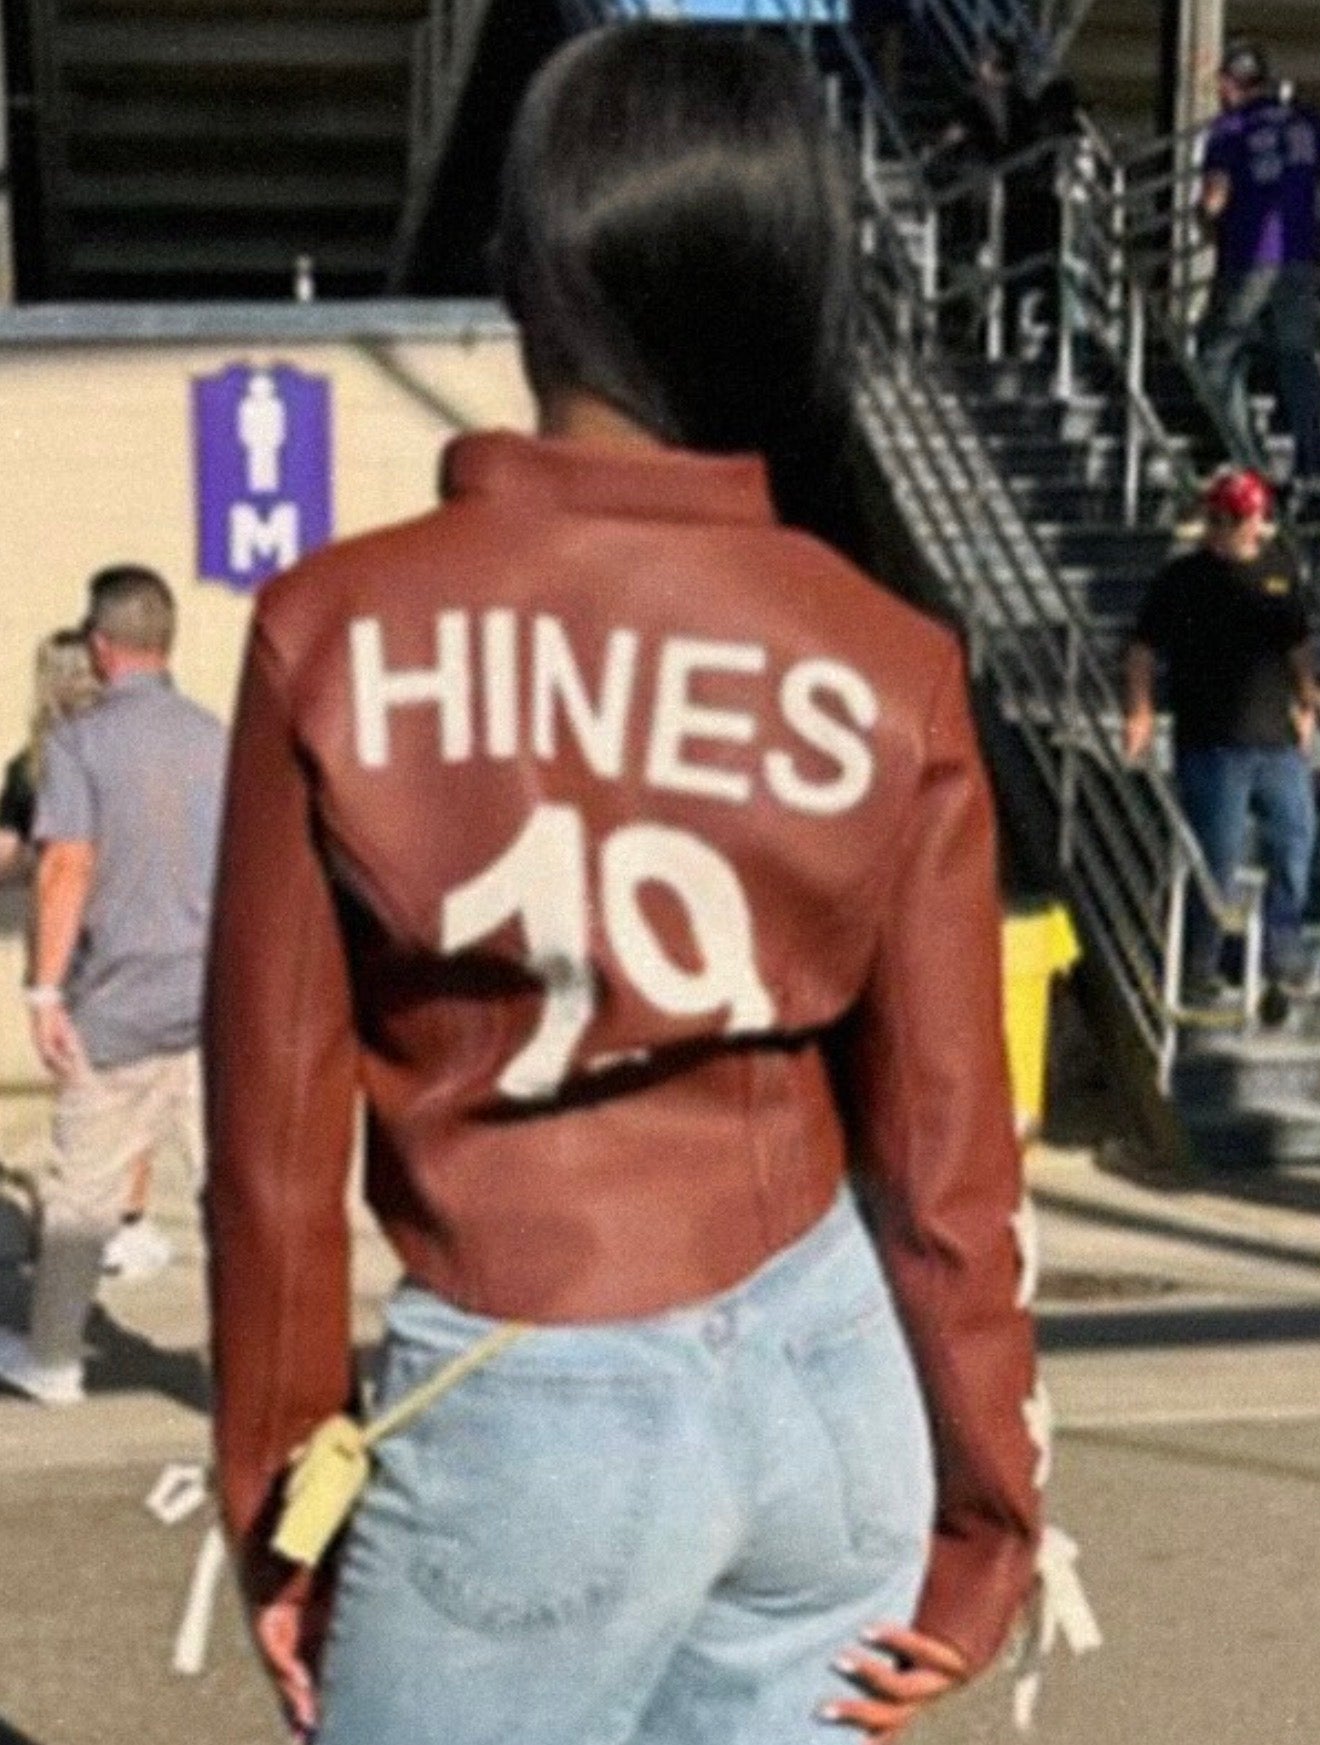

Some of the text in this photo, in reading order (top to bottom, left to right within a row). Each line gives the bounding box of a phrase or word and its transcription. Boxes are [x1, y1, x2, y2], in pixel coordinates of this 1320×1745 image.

[229, 502, 299, 573] M
[349, 607, 881, 817] HINES
[440, 803, 778, 1099] 19
